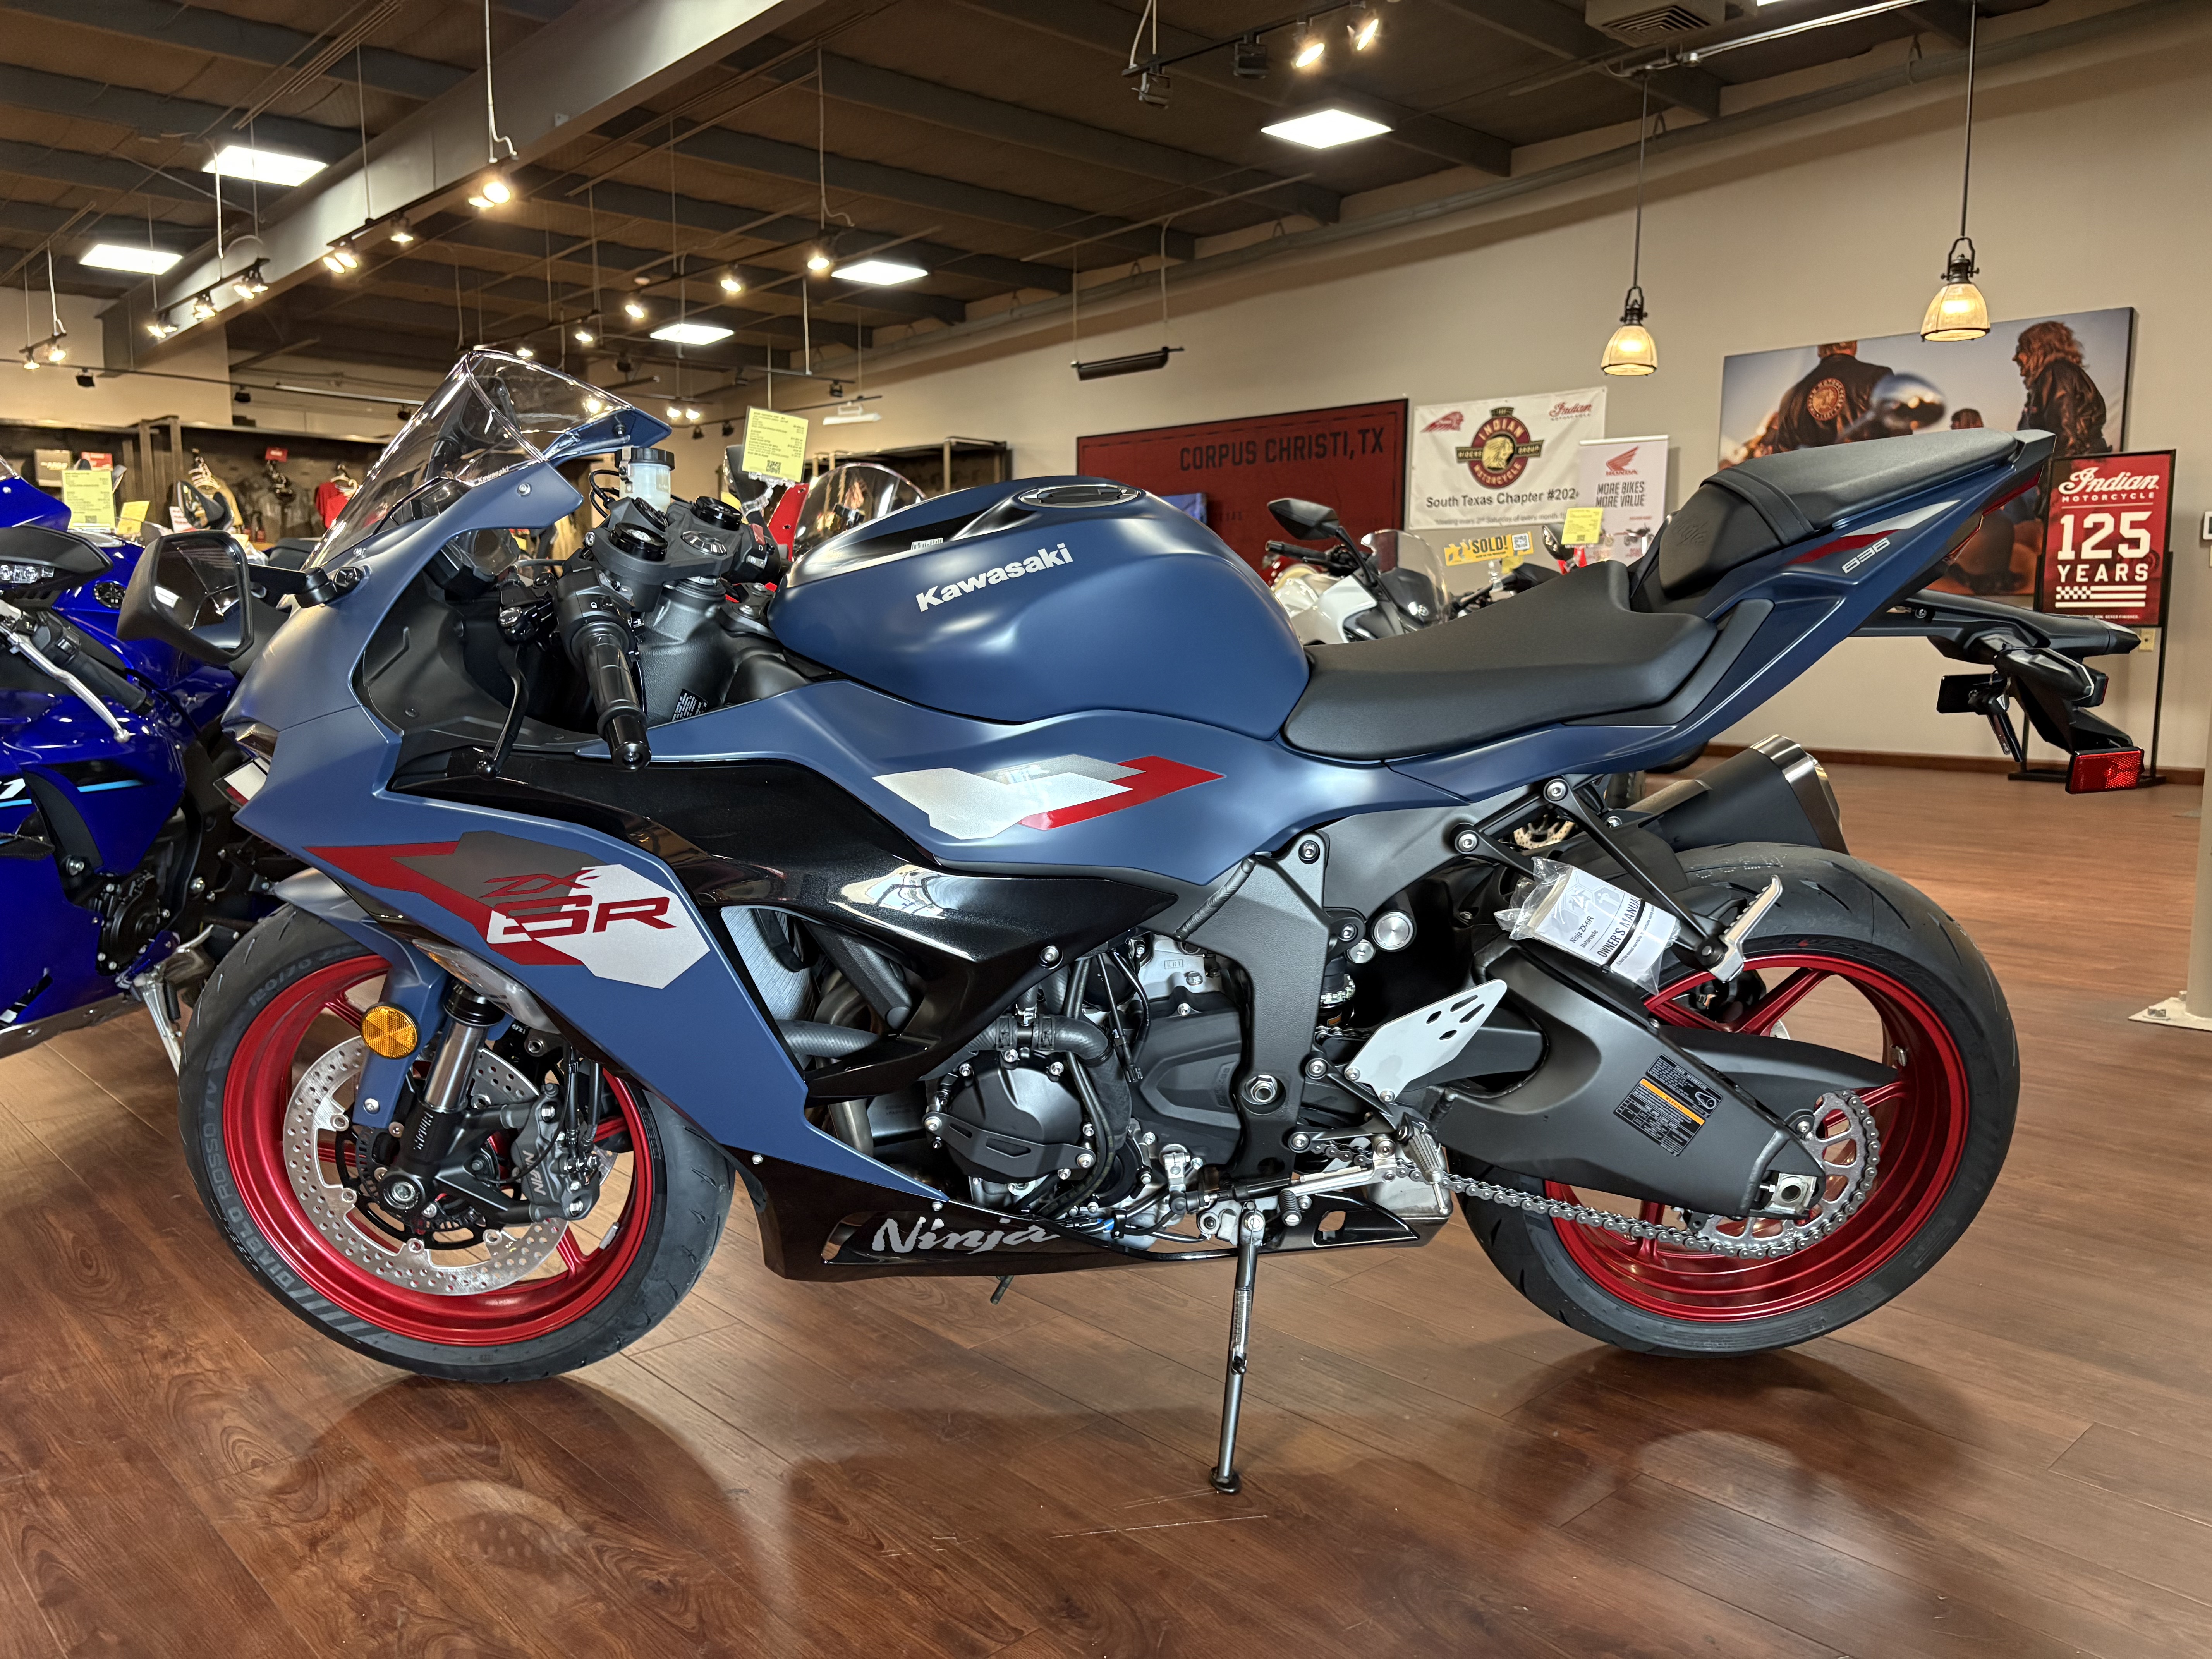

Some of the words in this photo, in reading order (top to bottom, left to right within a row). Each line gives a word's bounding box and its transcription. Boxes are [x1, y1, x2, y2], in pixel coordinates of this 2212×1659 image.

[1479, 420, 1525, 441] INDIAN
[1180, 441, 1257, 471] CORPUS
[1474, 462, 1522, 485] MOTORCYCLE
[2058, 467, 2159, 495] Indian
[1426, 495, 1458, 508] South
[1461, 494, 1492, 505] Texas
[1496, 491, 1543, 507] Chapter
[1597, 483, 1621, 495] MORE
[1621, 481, 1645, 494] BIKES
[2061, 492, 2154, 503] MOTORCYCLE
[1595, 495, 1618, 508] MORE
[1620, 494, 1645, 507] VALUE
[1473, 536, 1508, 554] SOLD!
[2057, 511, 2152, 560] 125
[1842, 537, 1890, 574] 636
[916, 543, 1073, 612] Kawasaki
[2057, 563, 2148, 583] YEARS
[1570, 931, 1582, 943] Ninja
[1578, 915, 1595, 933] ZX-6R
[1580, 929, 1599, 949] Motorcycle
[1597, 927, 1626, 958] OWNER'S
[1665, 1096, 1684, 1111] WARNING
[203, 1122, 233, 1200] ROSSO
[226, 1204, 295, 1288] DIABLO
[872, 1216, 1061, 1254] Ninja
